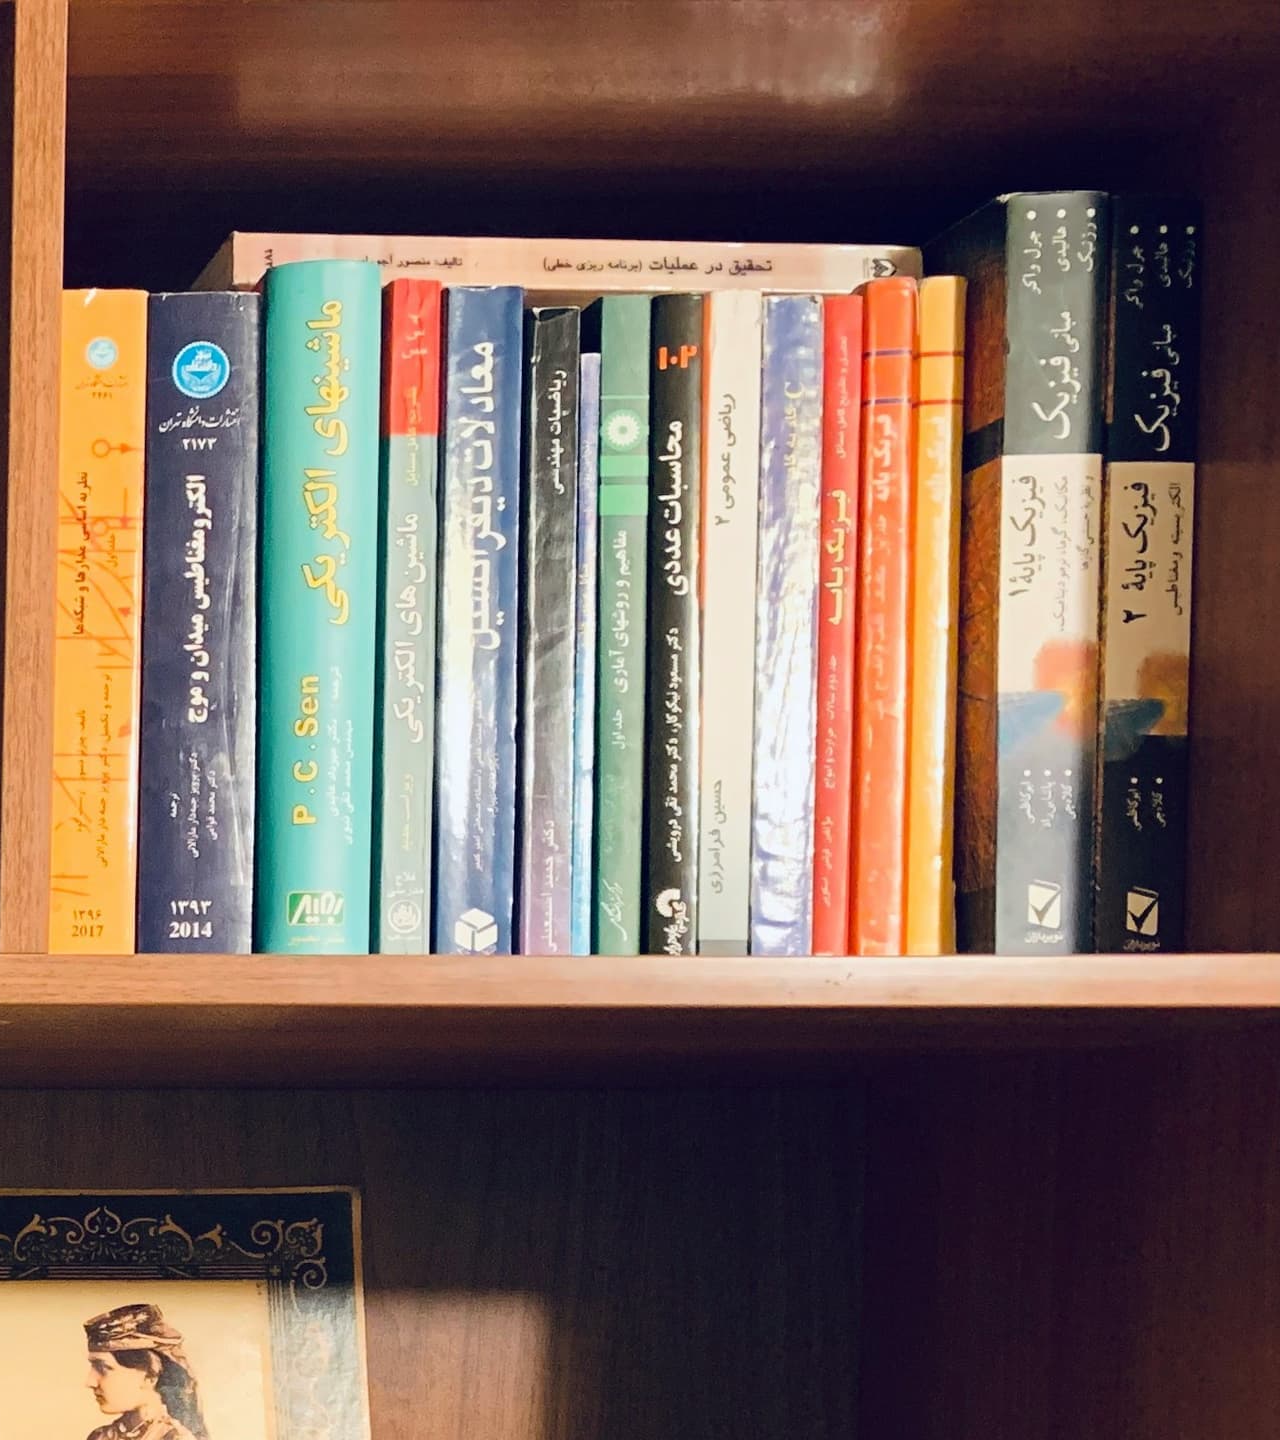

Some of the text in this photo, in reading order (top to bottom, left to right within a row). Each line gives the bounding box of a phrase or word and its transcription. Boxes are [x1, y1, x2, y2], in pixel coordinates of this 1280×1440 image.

[648, 256, 773, 275] تحقیق در عملیات
[547, 370, 571, 495] ریاضیات مهندسی
[1031, 311, 1081, 440] مبانی فیزیک
[299, 298, 350, 626] ماشینهای الکتریکی
[455, 340, 506, 650] معادلات دیفرانسیل
[657, 420, 689, 596] محاسبات عددی
[715, 393, 736, 527] ریاضی عمومی ۲
[183, 473, 213, 724] الکترومغناطیس میدان و موج
[293, 675, 319, 738] Sen
[71, 924, 104, 938] 2017
[168, 921, 214, 939] 2014
[169, 900, 213, 916] ۱۳۹۳
